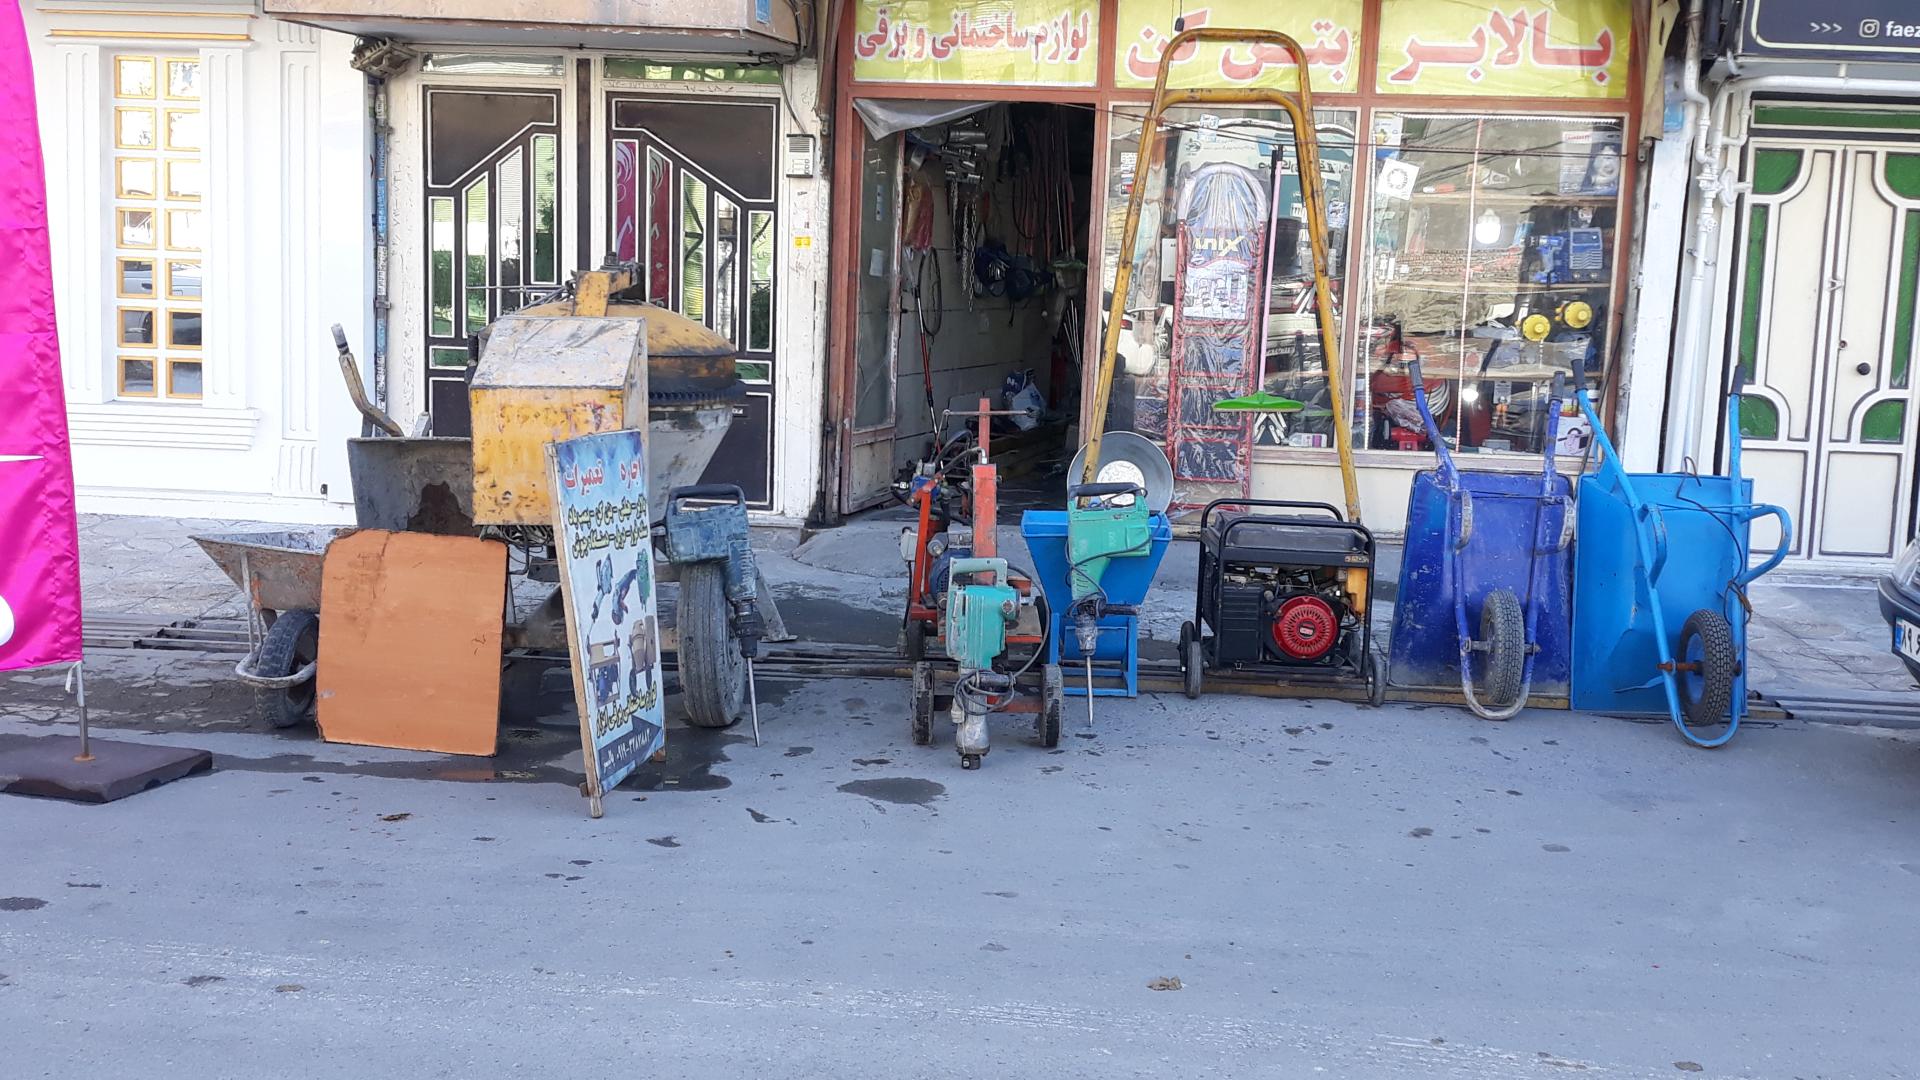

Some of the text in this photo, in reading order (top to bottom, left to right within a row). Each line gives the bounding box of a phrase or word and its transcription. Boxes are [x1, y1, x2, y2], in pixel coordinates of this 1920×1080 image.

[857, 9, 1088, 61] لوازم ساختمانی و برقی
[1390, 9, 1612, 83] بالابر
[564, 459, 641, 495] اجاره تعمیرات
